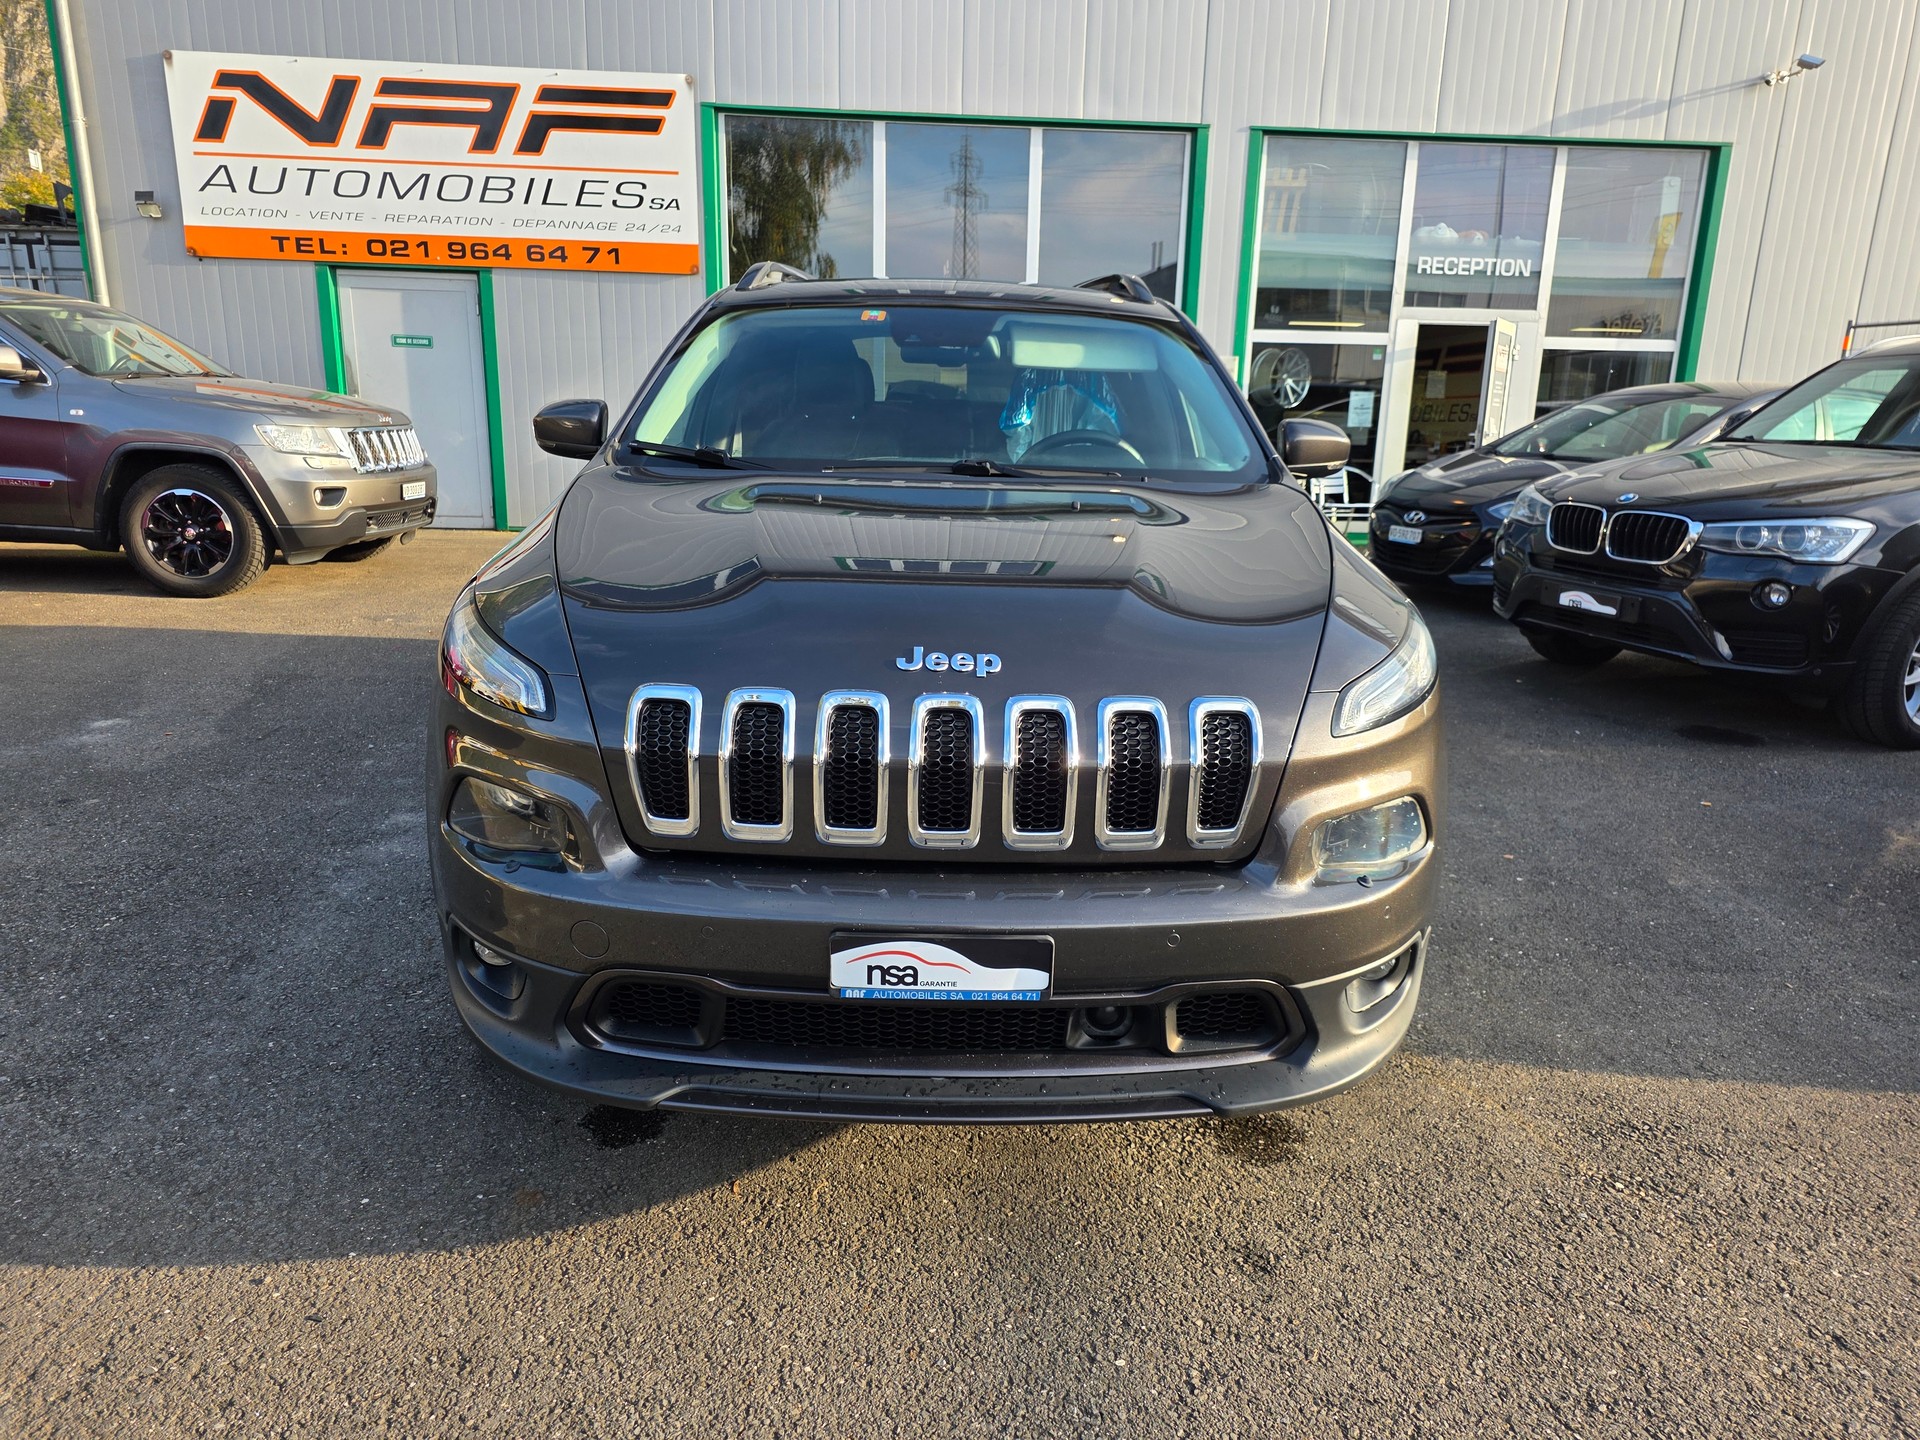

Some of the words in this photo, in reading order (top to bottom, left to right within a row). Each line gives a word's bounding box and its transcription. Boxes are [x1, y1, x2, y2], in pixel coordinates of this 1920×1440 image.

[193, 69, 677, 155] NAF
[198, 164, 648, 210] AUTOMOBILES
[649, 198, 681, 211] SA
[200, 206, 288, 218] LOCATION
[309, 210, 365, 222] VENTE
[384, 213, 493, 227] REPARATION
[513, 218, 618, 231] DEPANNAGE
[625, 222, 682, 234] 24/24
[271, 236, 348, 256] TEL:
[366, 239, 430, 259] 021
[447, 241, 512, 261] 964
[526, 244, 568, 263] 64
[582, 246, 620, 265] 71
[1417, 255, 1532, 277] RECEPTION
[896, 646, 1002, 678] Jeep
[867, 964, 919, 986] nsa
[872, 990, 947, 1000] AUTOMOBILES
[950, 991, 964, 1000] SA
[971, 992, 988, 1000] 021
[991, 992, 1008, 1001] 964
[1011, 992, 1023, 1001] 64
[1026, 992, 1036, 1001] 71
